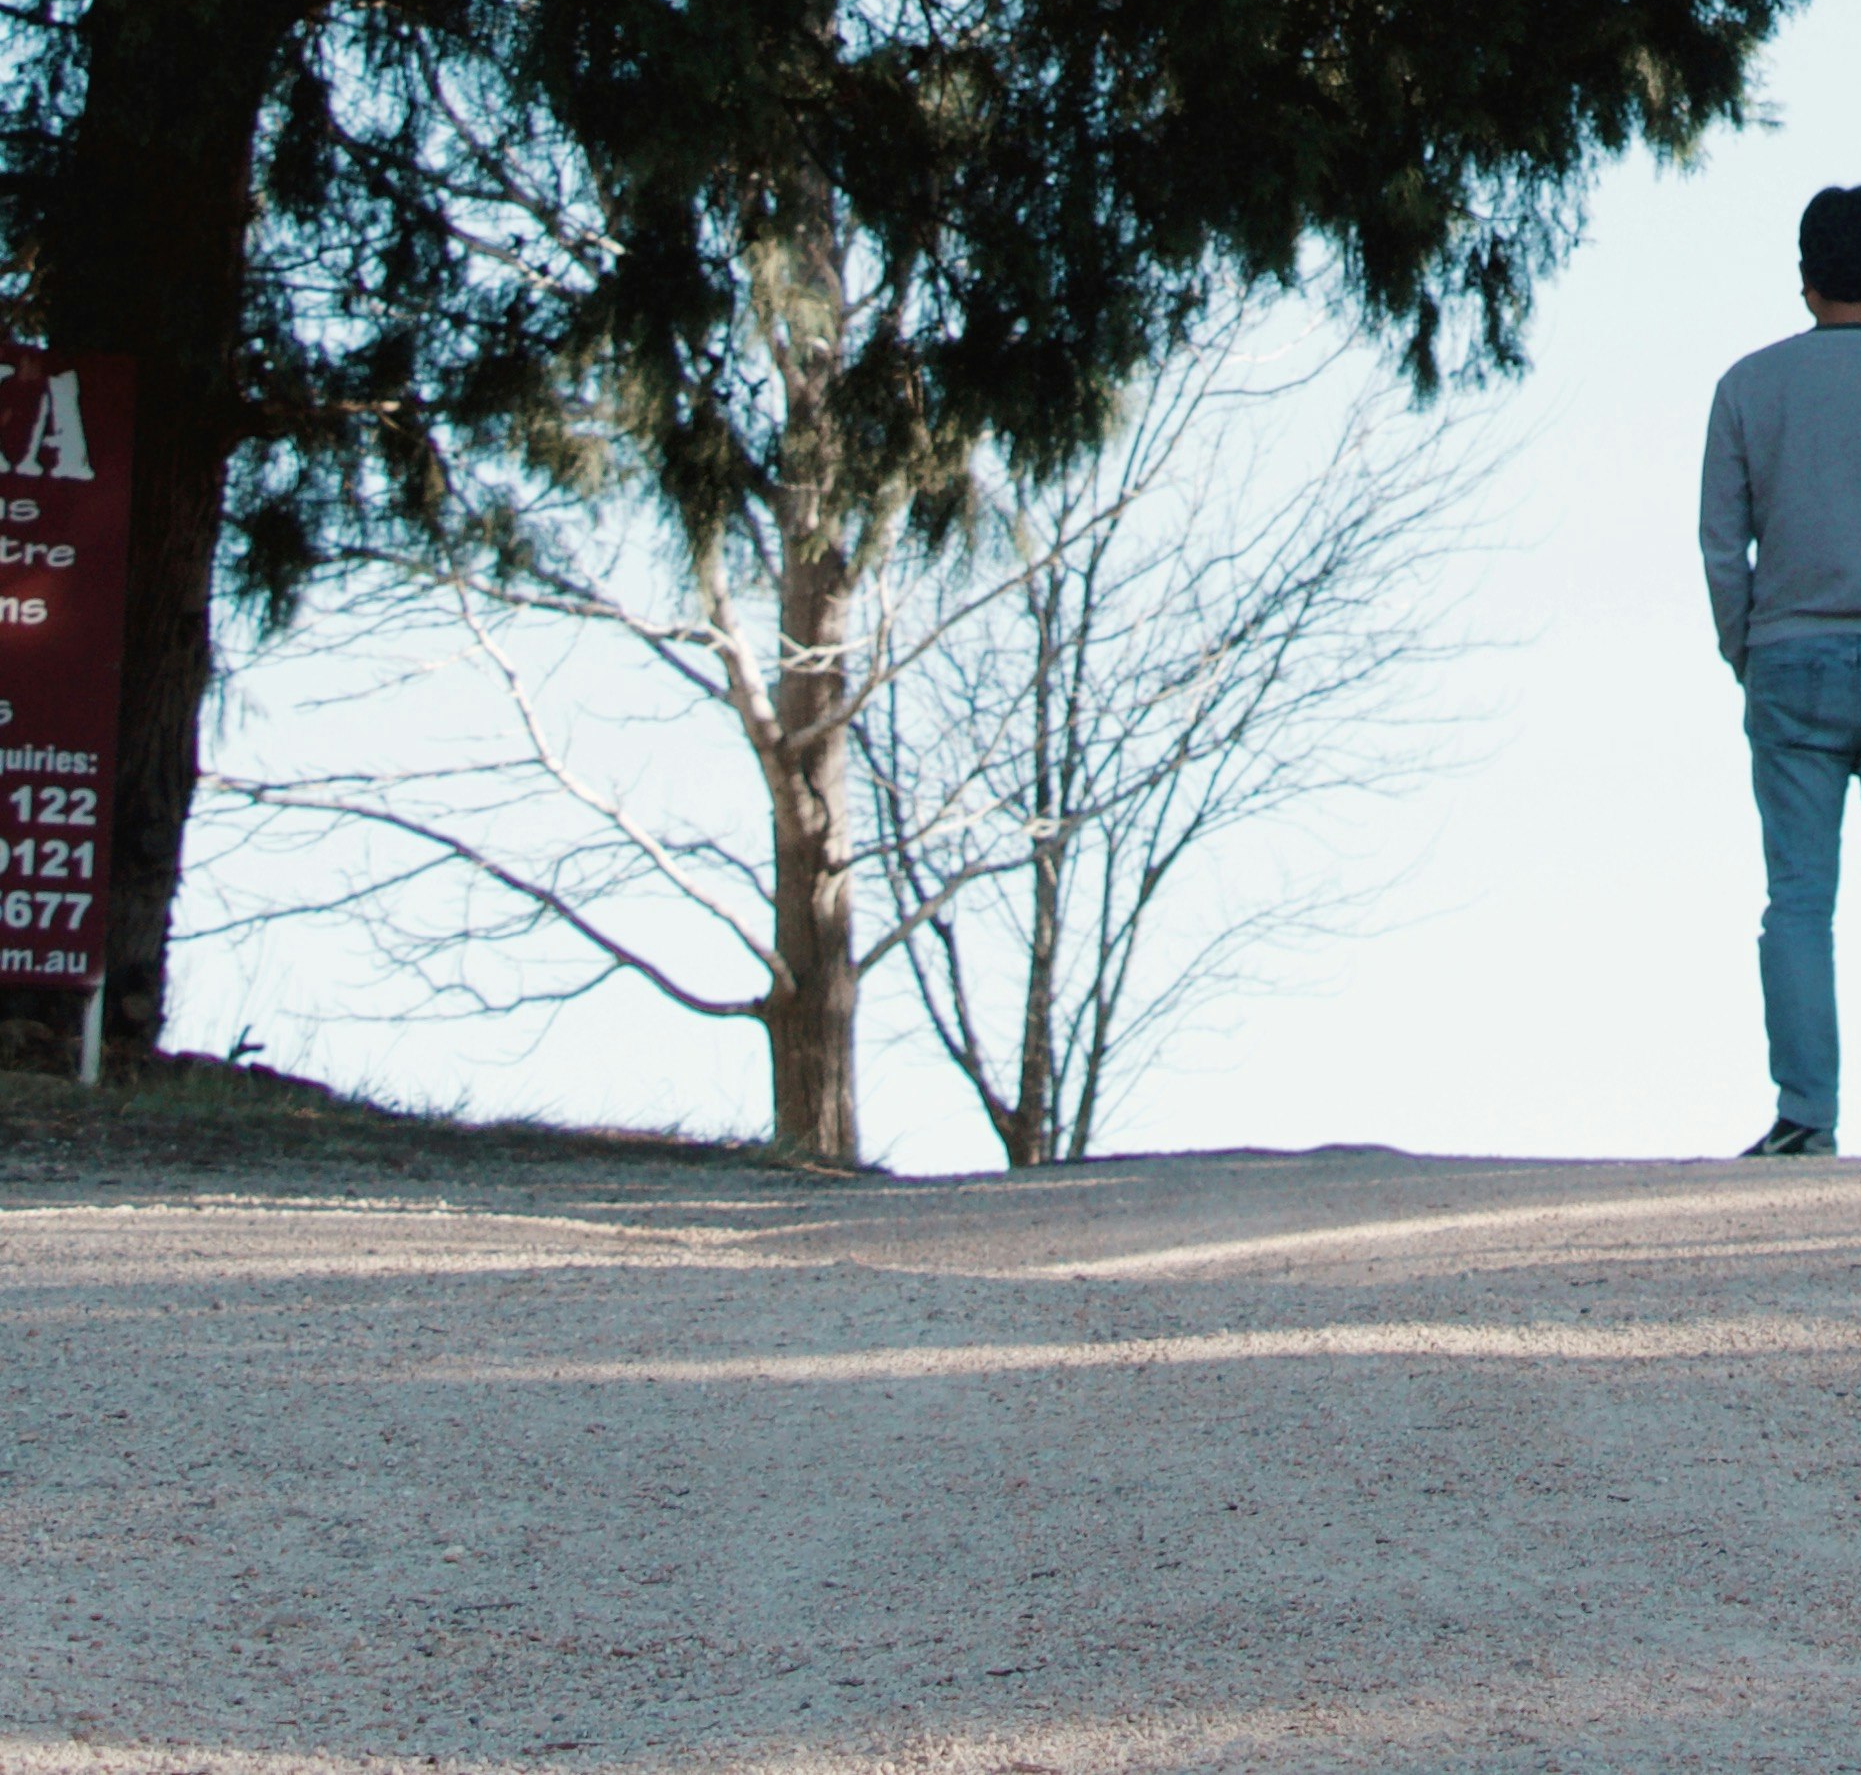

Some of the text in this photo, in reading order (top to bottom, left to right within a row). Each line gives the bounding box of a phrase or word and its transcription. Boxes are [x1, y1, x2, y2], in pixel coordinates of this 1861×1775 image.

[0, 364, 95, 480] A
[0, 497, 40, 522] s
[9, 785, 97, 825] 122
[0, 890, 93, 930] 677
[0, 948, 88, 974] m.au
